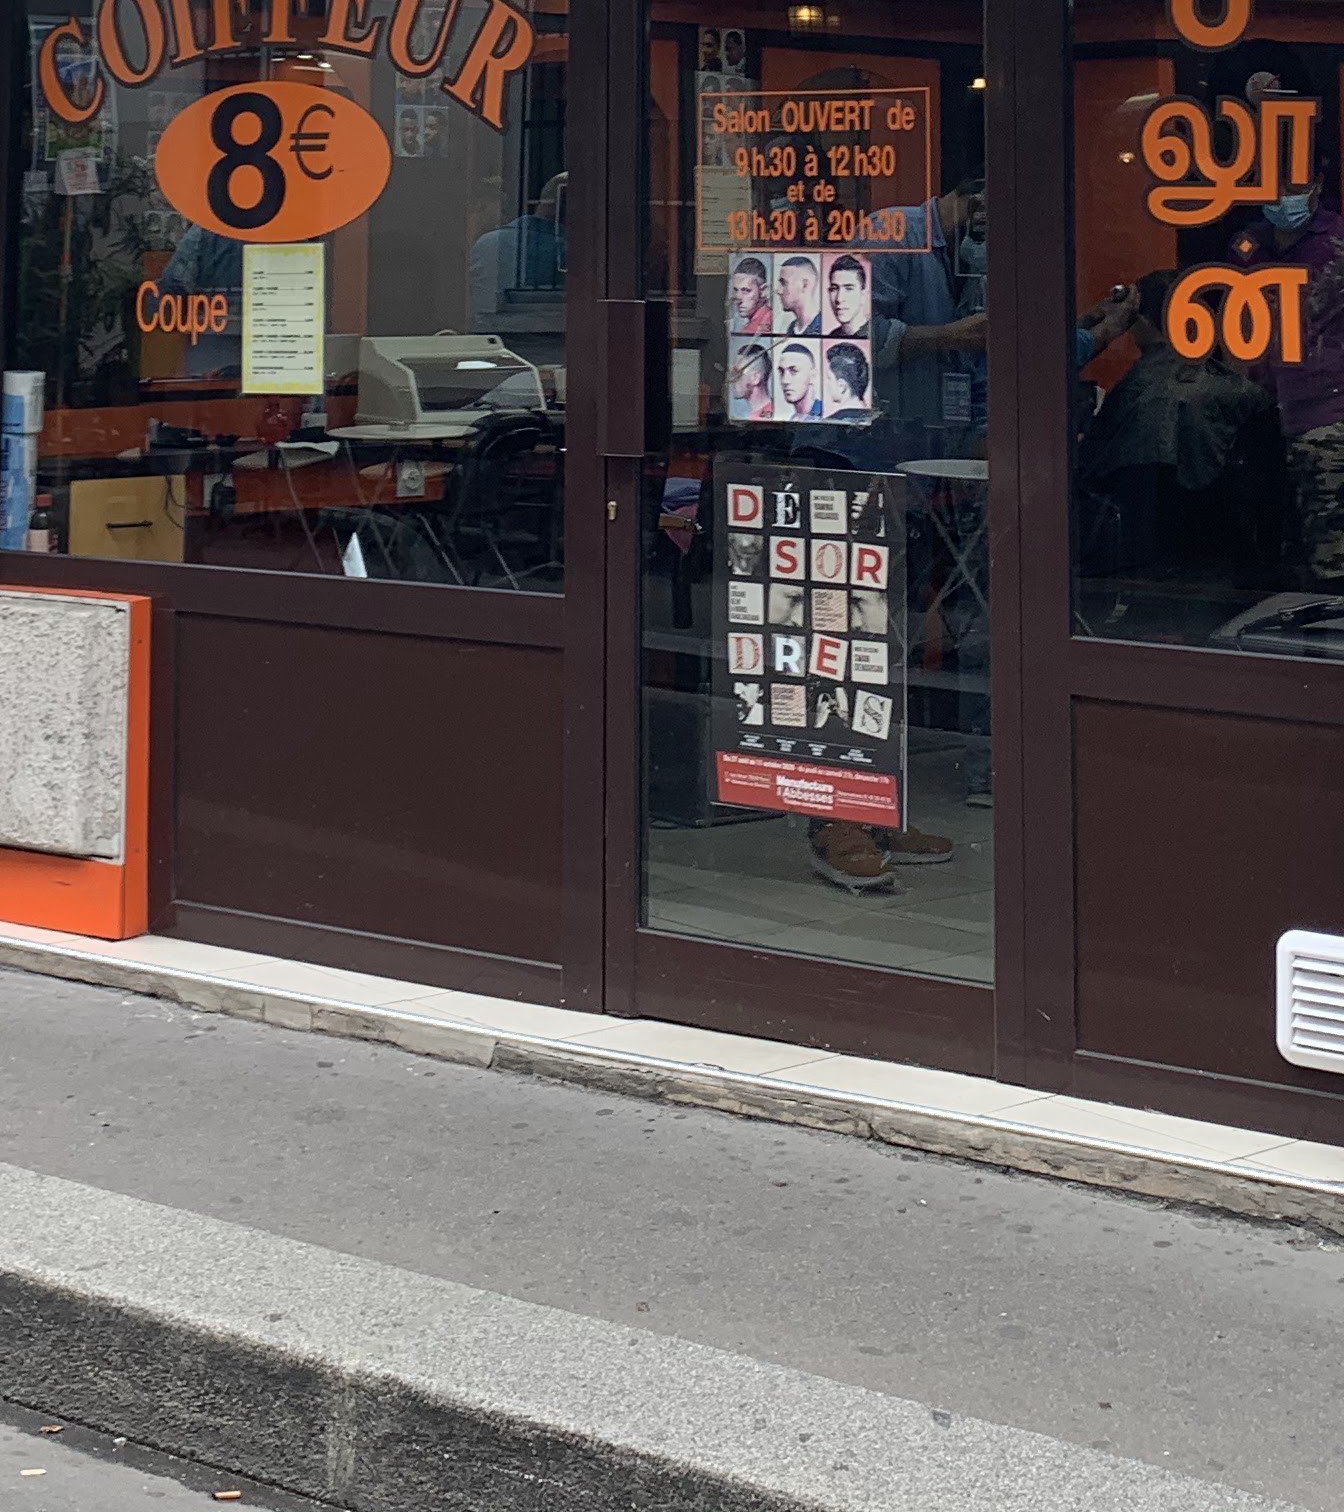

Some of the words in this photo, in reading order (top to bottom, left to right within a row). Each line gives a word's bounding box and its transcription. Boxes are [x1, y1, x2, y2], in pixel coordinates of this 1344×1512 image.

[712, 102, 771, 134] Salon
[781, 99, 875, 133] OUVERT
[886, 98, 916, 131] de
[804, 144, 819, 177] à
[786, 180, 805, 203] et
[812, 179, 837, 203] de
[804, 209, 820, 242] à
[135, 280, 229, 344] Coupe
